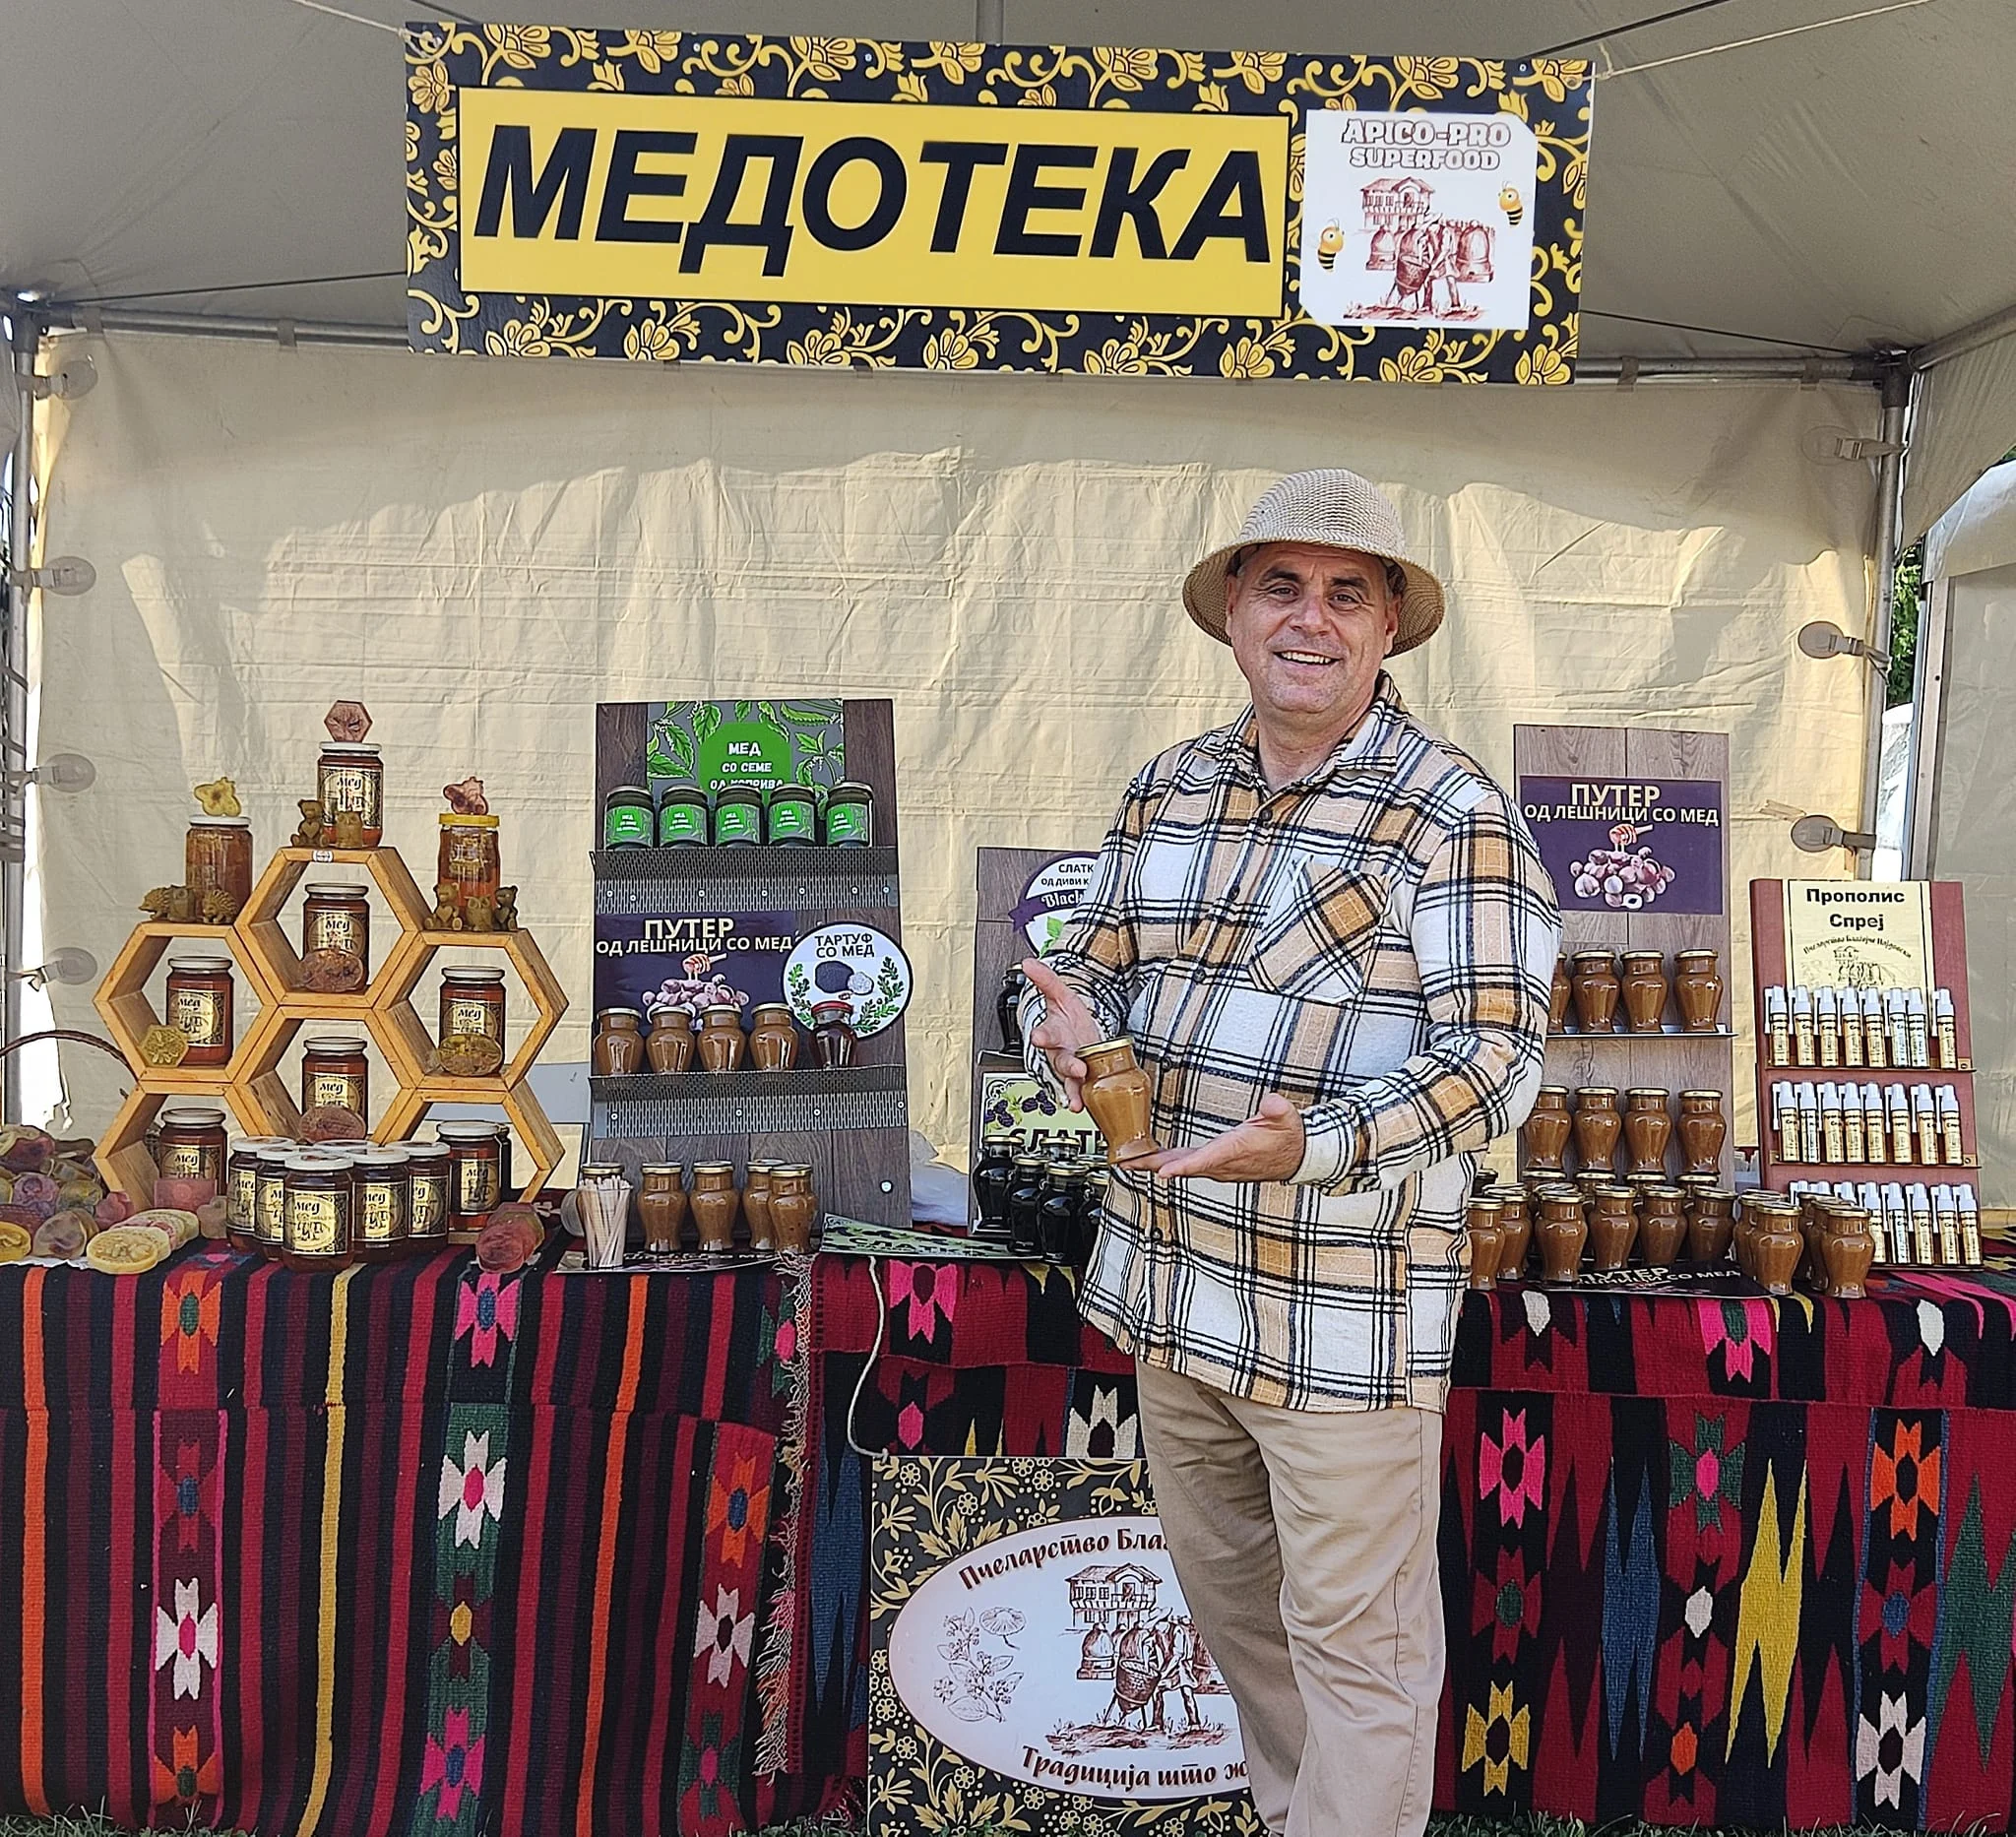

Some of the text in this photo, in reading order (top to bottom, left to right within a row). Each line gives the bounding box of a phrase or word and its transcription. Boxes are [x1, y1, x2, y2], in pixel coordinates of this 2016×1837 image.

[1341, 119, 1511, 147] APICO-PRO
[1350, 147, 1501, 170] SUPERFOOD
[473, 124, 1272, 277] МЕДОТЕКА
[728, 742, 761, 756] МЕД
[722, 762, 772, 773] СО СЕМЕ
[1571, 784, 1661, 808] ПУТЕР
[1524, 804, 1720, 826] ОД ЛЕШНИЦИ СО МЕД
[1058, 863, 1094, 873] СЛАТК
[1040, 889, 1083, 908] Black
[1806, 888, 1906, 906] Прополис
[644, 917, 735, 939] ПУТЕР
[1829, 914, 1884, 931] Спреј
[596, 936, 793, 956] ОД ЛЕШНИЦИ СО МЕД
[814, 933, 873, 947] ТАРТУФ
[816, 944, 875, 958] СО МЕД
[958, 1528, 1169, 1590] Пчеларство Бла
[1022, 1745, 1150, 1792] Традиција
[1158, 1763, 1217, 1786] што
